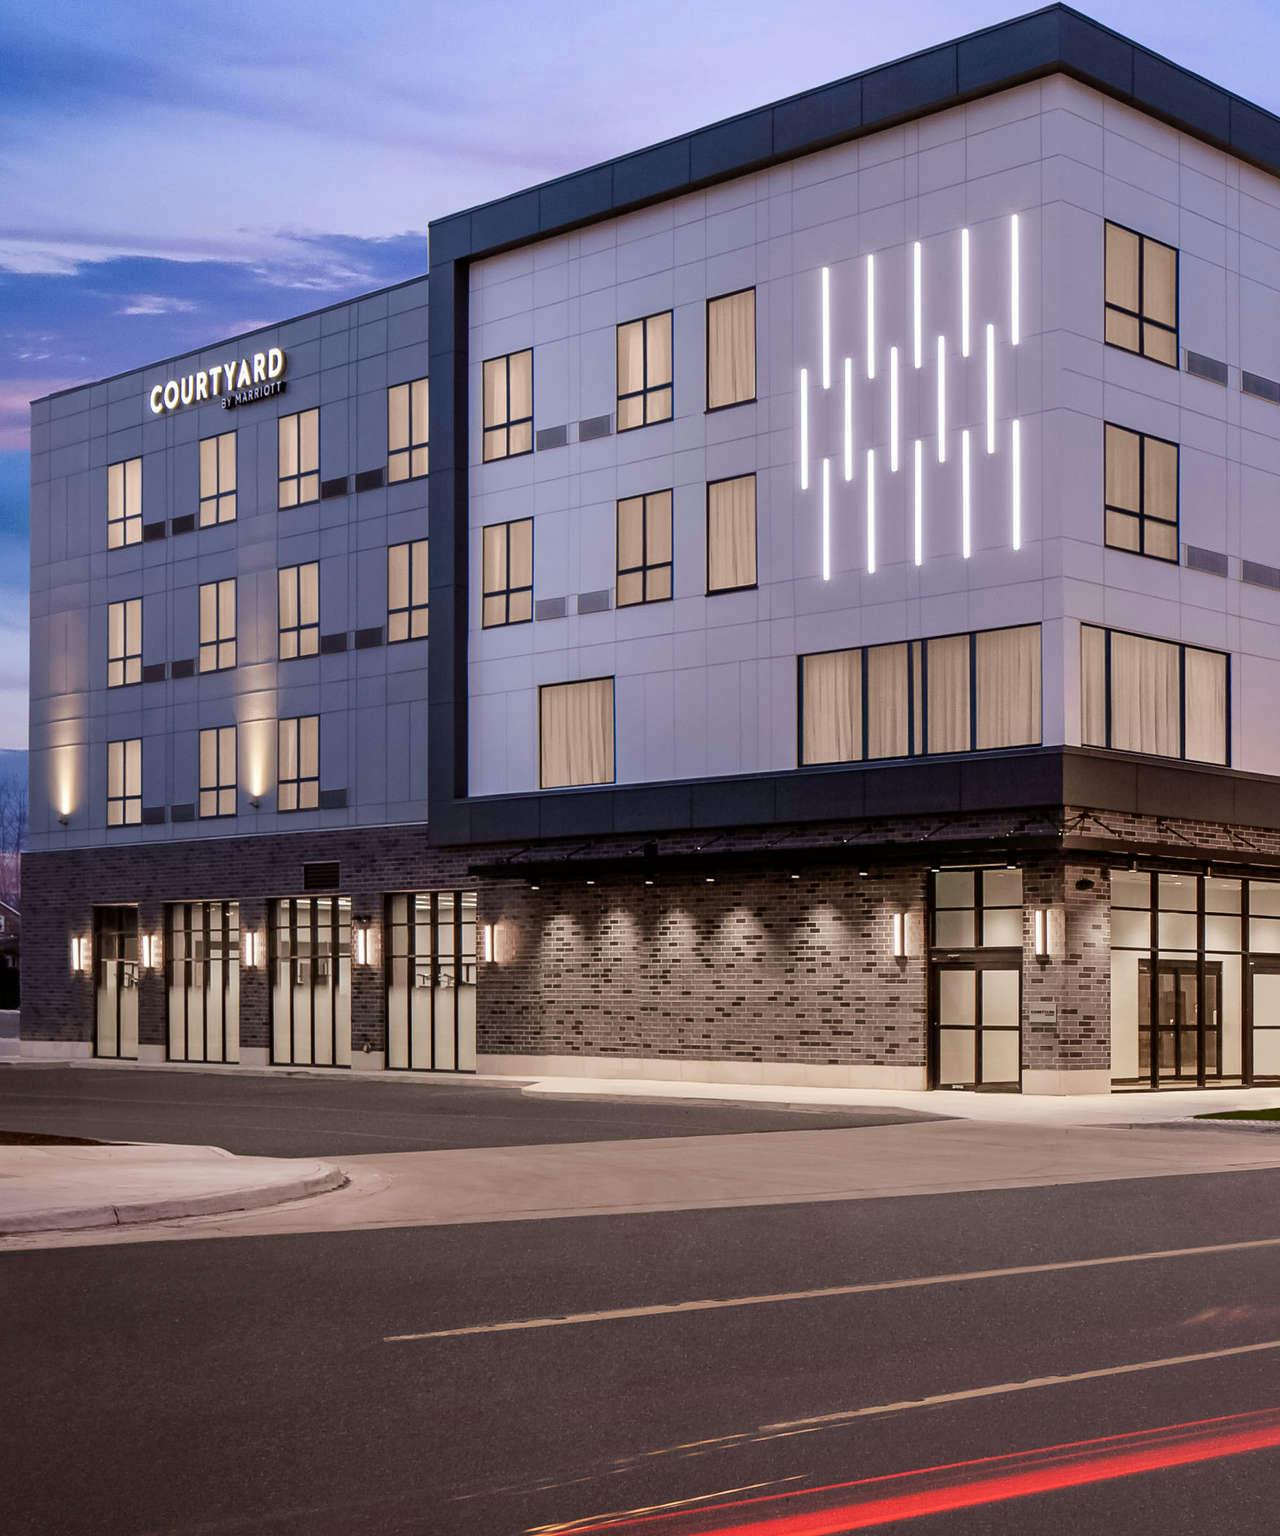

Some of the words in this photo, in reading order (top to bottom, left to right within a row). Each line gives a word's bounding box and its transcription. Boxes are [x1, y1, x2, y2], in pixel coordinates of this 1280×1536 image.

[150, 347, 285, 414] COURTYARD
[221, 397, 233, 409] BY
[235, 380, 282, 406] MARRIOTT
